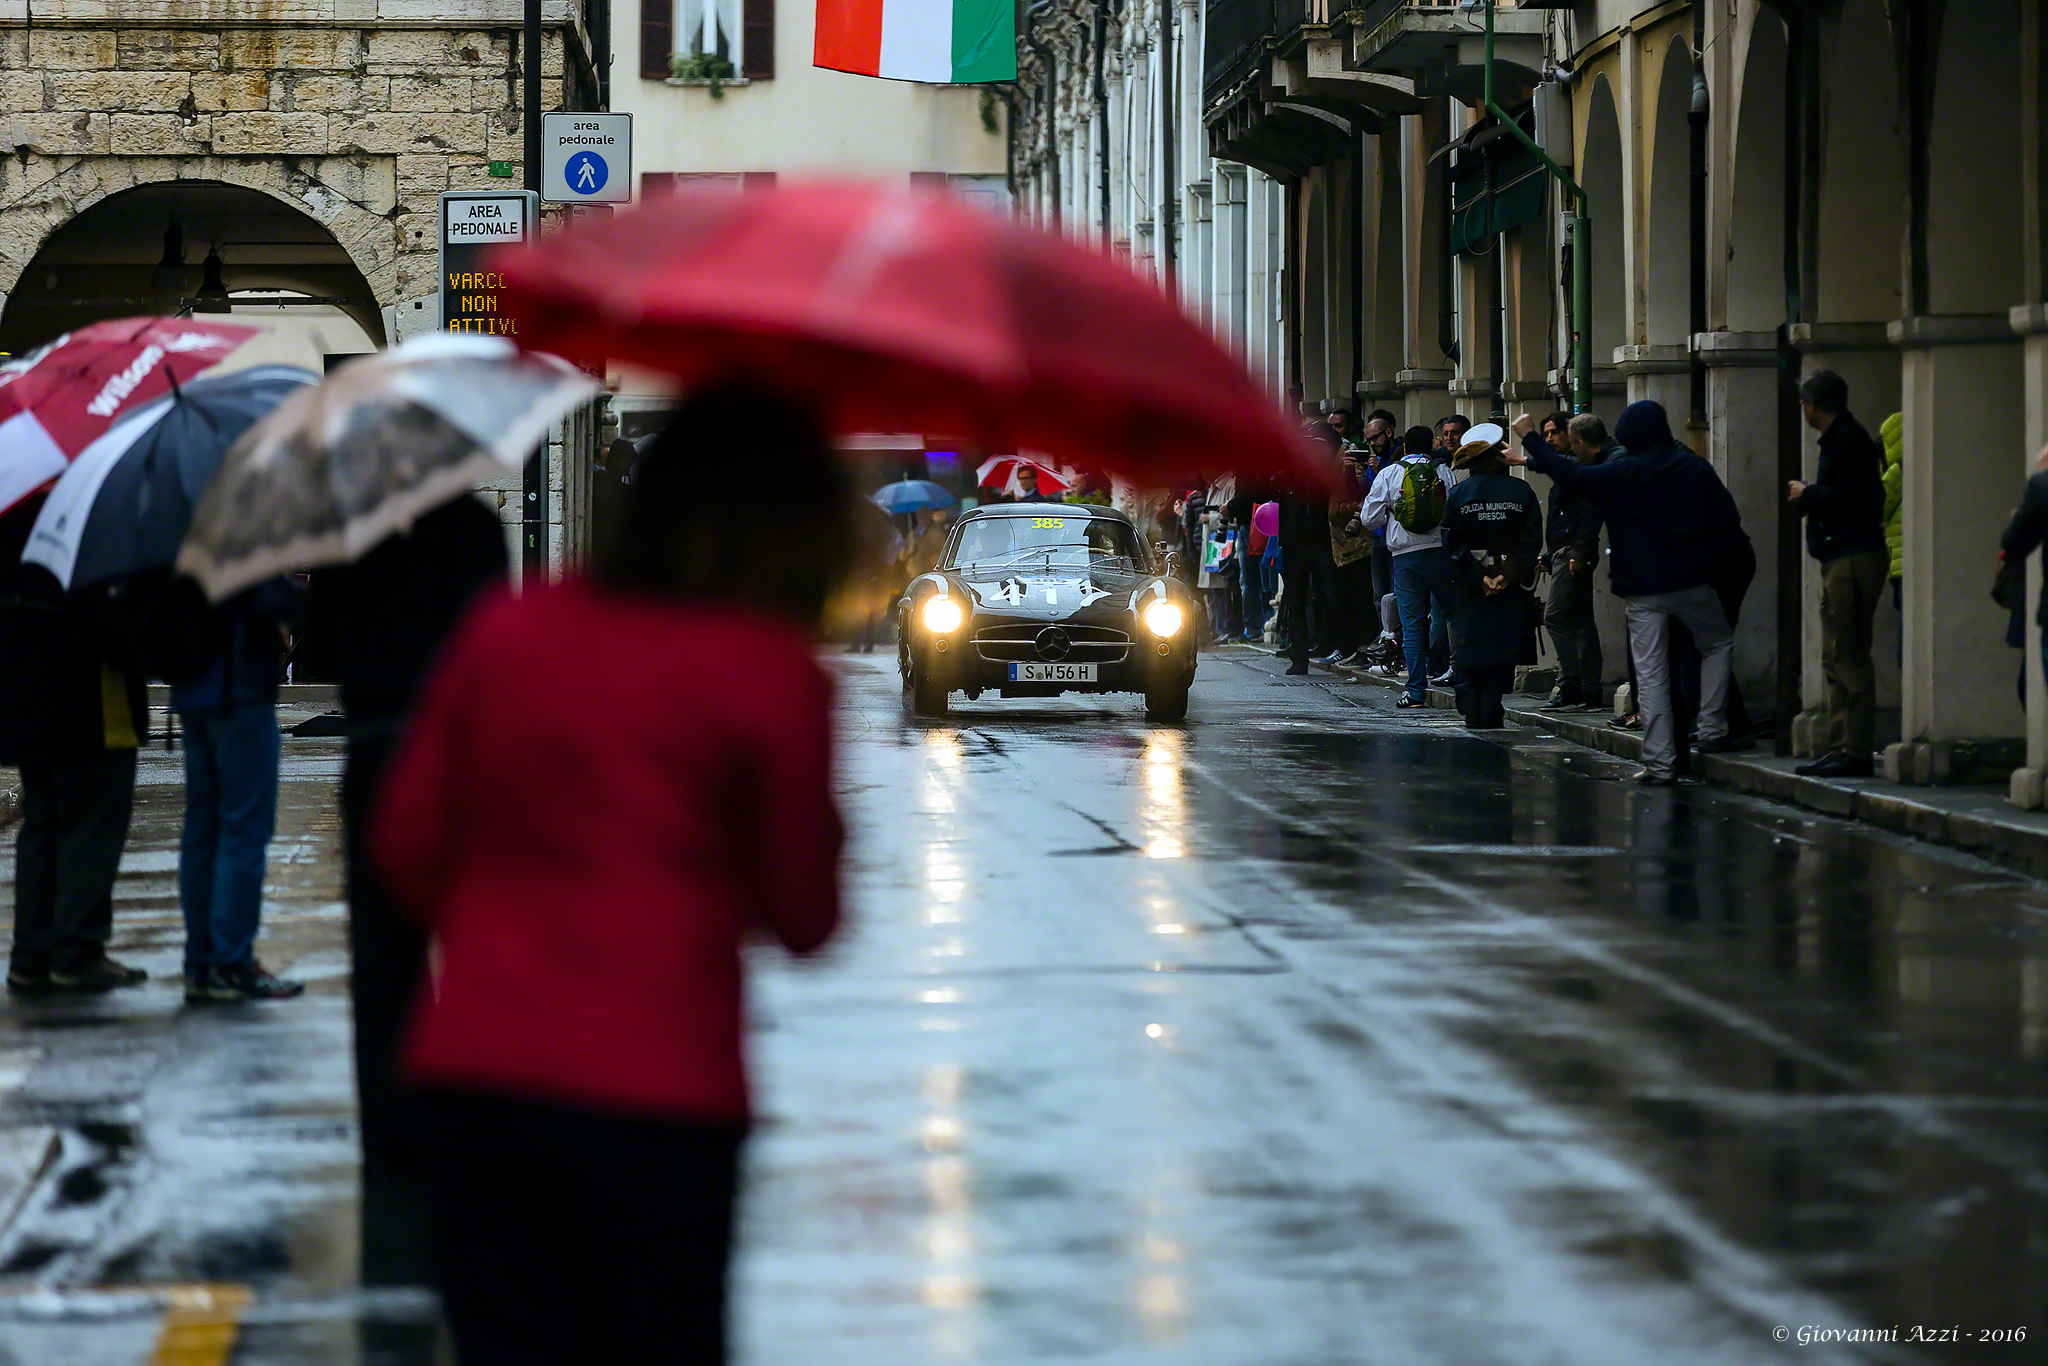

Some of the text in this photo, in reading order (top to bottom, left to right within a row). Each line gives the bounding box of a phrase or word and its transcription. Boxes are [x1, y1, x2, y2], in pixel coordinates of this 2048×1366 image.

[573, 122, 600, 131] area
[559, 134, 615, 146] pedonale
[468, 205, 502, 218] AREA
[452, 222, 518, 235] PEDONALE
[461, 295, 497, 312] NON
[1460, 502, 1523, 515] POLIZIA MUNICIPALE
[1478, 512, 1506, 521] BRESCIA
[1031, 518, 1064, 529] 385
